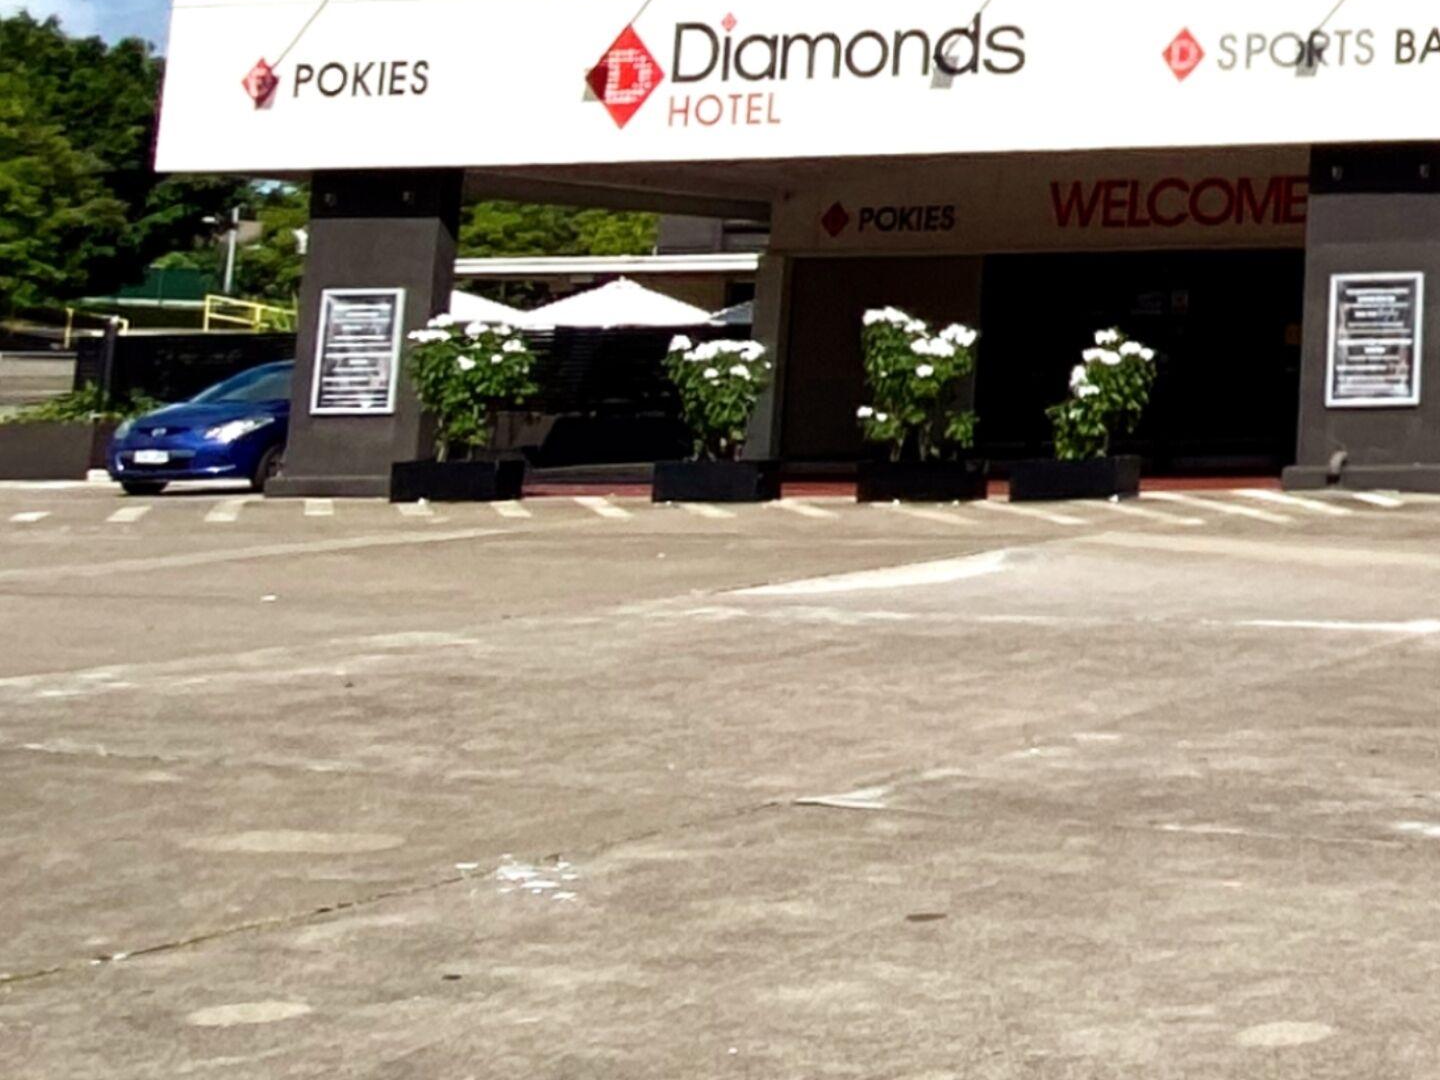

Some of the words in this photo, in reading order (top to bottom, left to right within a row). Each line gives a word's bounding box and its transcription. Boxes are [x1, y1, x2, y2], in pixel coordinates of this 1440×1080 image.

[671, 11, 1026, 83] Diamonds
[1216, 29, 1375, 72] SPORTS
[293, 60, 429, 98] POKIES
[667, 92, 781, 127] HOTEL
[858, 205, 956, 233] POKIES
[1050, 175, 1310, 229] WELCOME
